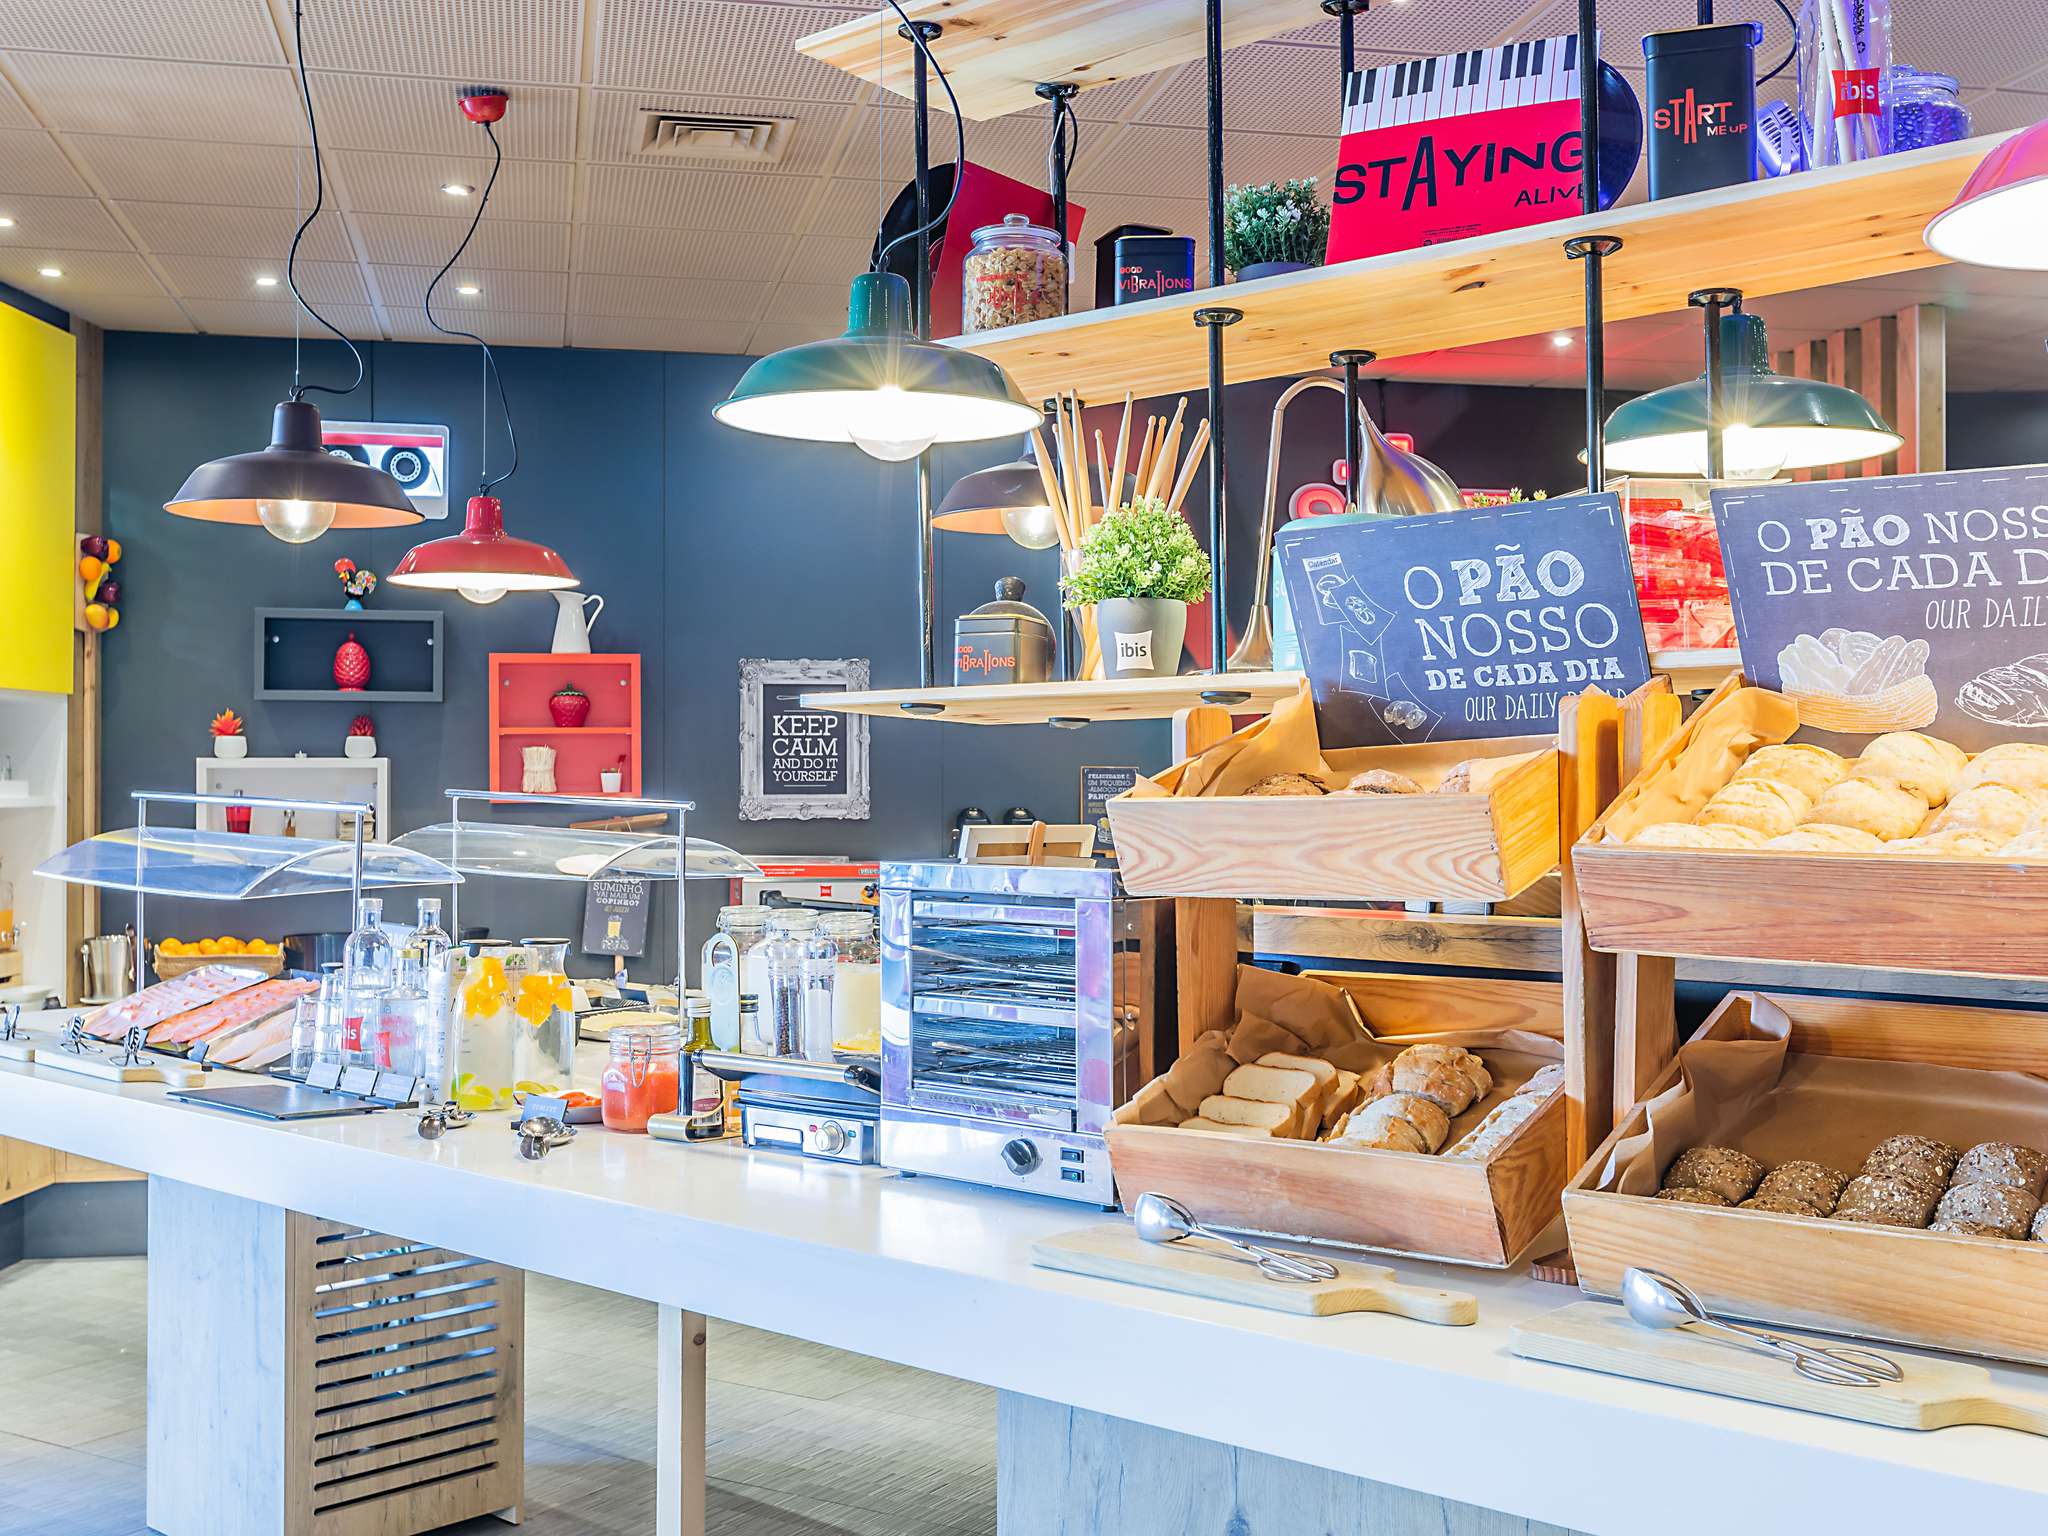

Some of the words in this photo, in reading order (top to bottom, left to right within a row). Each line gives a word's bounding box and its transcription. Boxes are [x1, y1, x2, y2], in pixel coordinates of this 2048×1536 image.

[1840, 80, 1876, 101] ibis
[1654, 88, 1735, 145] START
[1706, 125, 1728, 137] ME
[1729, 123, 1748, 134] UP
[1333, 130, 1582, 212] STAYING
[1119, 270, 1193, 299] VIBRATIONS
[1758, 519, 1792, 553] O
[1804, 507, 1911, 551] PÃO
[1403, 565, 1444, 610] O
[1450, 543, 1586, 607] PÃO
[1760, 559, 1833, 596] DE
[1846, 551, 2003, 593] CADA
[1925, 599, 1971, 630] OUR
[1983, 595, 2048, 629] DAIL
[1414, 602, 1620, 661] NOSSO
[955, 645, 974, 655] OOD
[1120, 642, 1148, 659] ibis
[1425, 667, 1468, 691] DE
[1473, 661, 1560, 688] CADA
[1563, 656, 1626, 683] DIA
[1465, 695, 1498, 723] OUR
[1504, 690, 1559, 722] DAILY
[772, 715, 839, 737] KEEP
[772, 737, 839, 757] CALM
[772, 758, 800, 769] AND
[803, 758, 824, 769] DO
[826, 758, 839, 769] IT
[772, 770, 839, 782] YOURSELF
